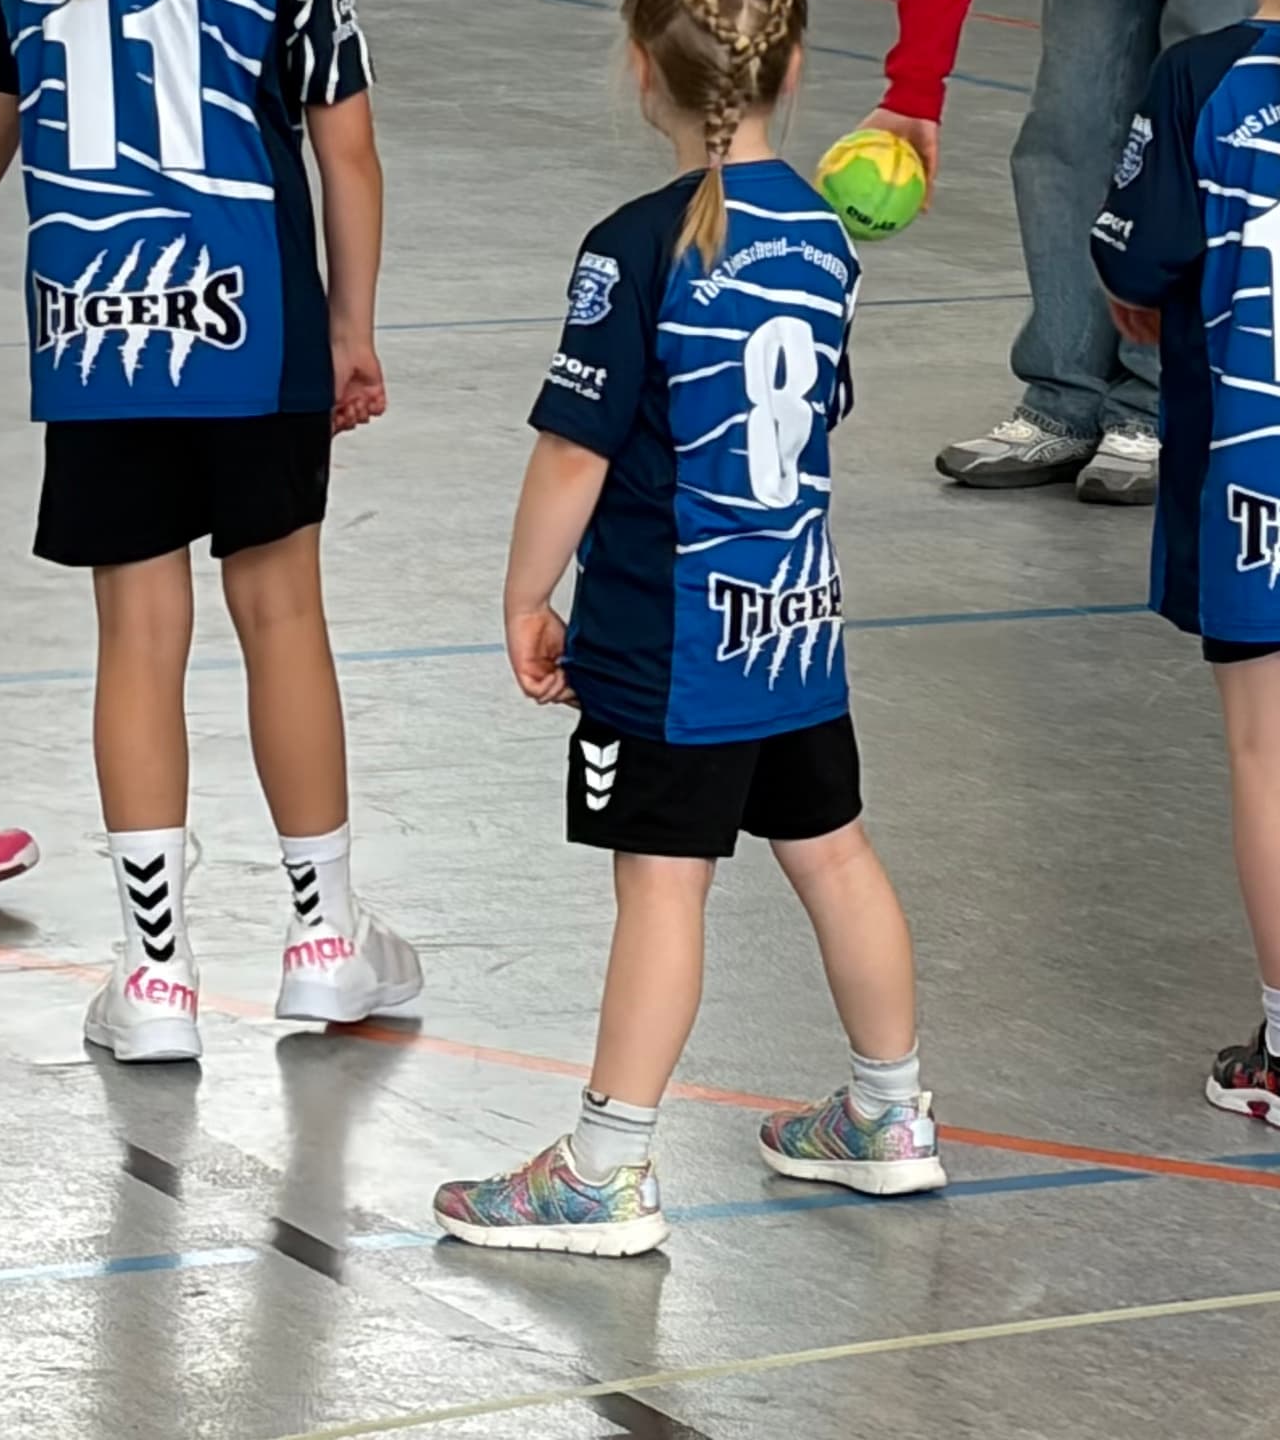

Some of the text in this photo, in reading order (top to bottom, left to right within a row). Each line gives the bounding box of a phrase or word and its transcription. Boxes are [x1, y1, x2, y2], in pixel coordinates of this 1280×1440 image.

[33, 265, 247, 351] TIGERS
[742, 314, 819, 510] 8
[708, 571, 844, 662] TIGER
[124, 965, 197, 1019] Kem
